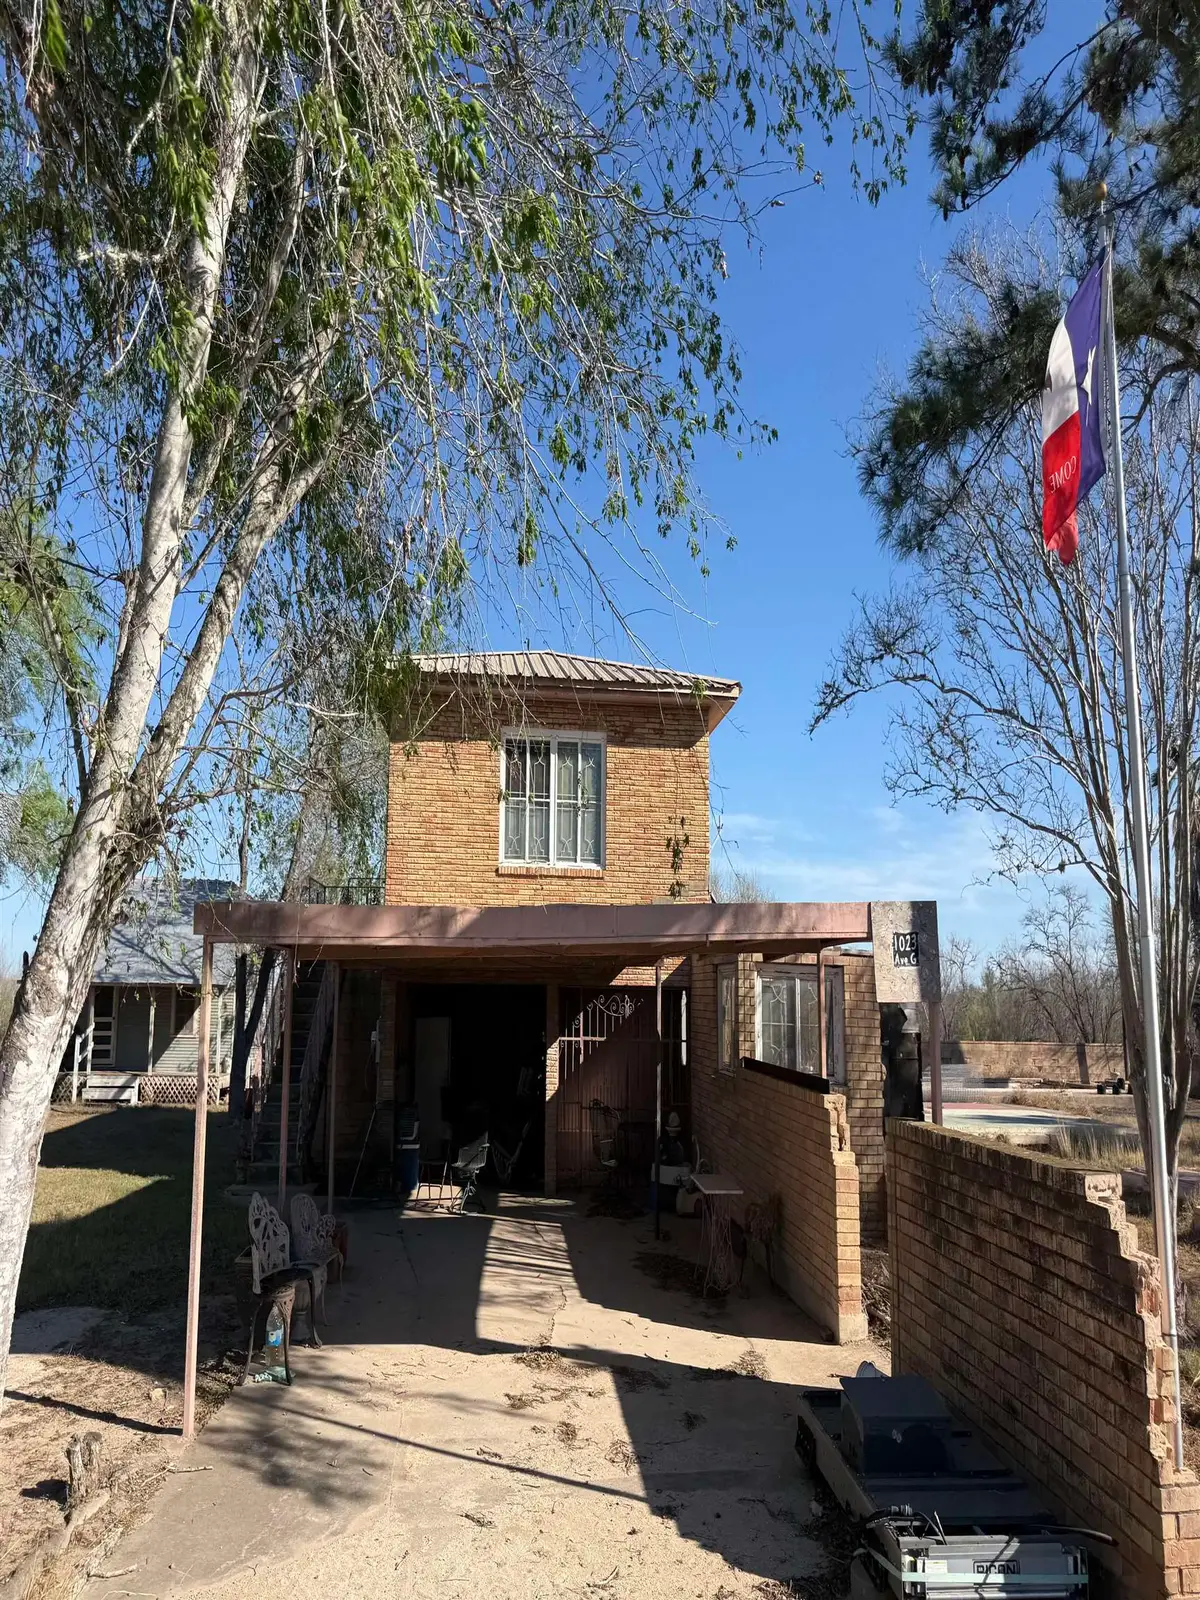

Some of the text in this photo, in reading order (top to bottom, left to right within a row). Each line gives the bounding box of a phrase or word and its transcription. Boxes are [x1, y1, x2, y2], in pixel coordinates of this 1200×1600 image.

[894, 933, 917, 952] 1023
[894, 952, 917, 966] Ave G
